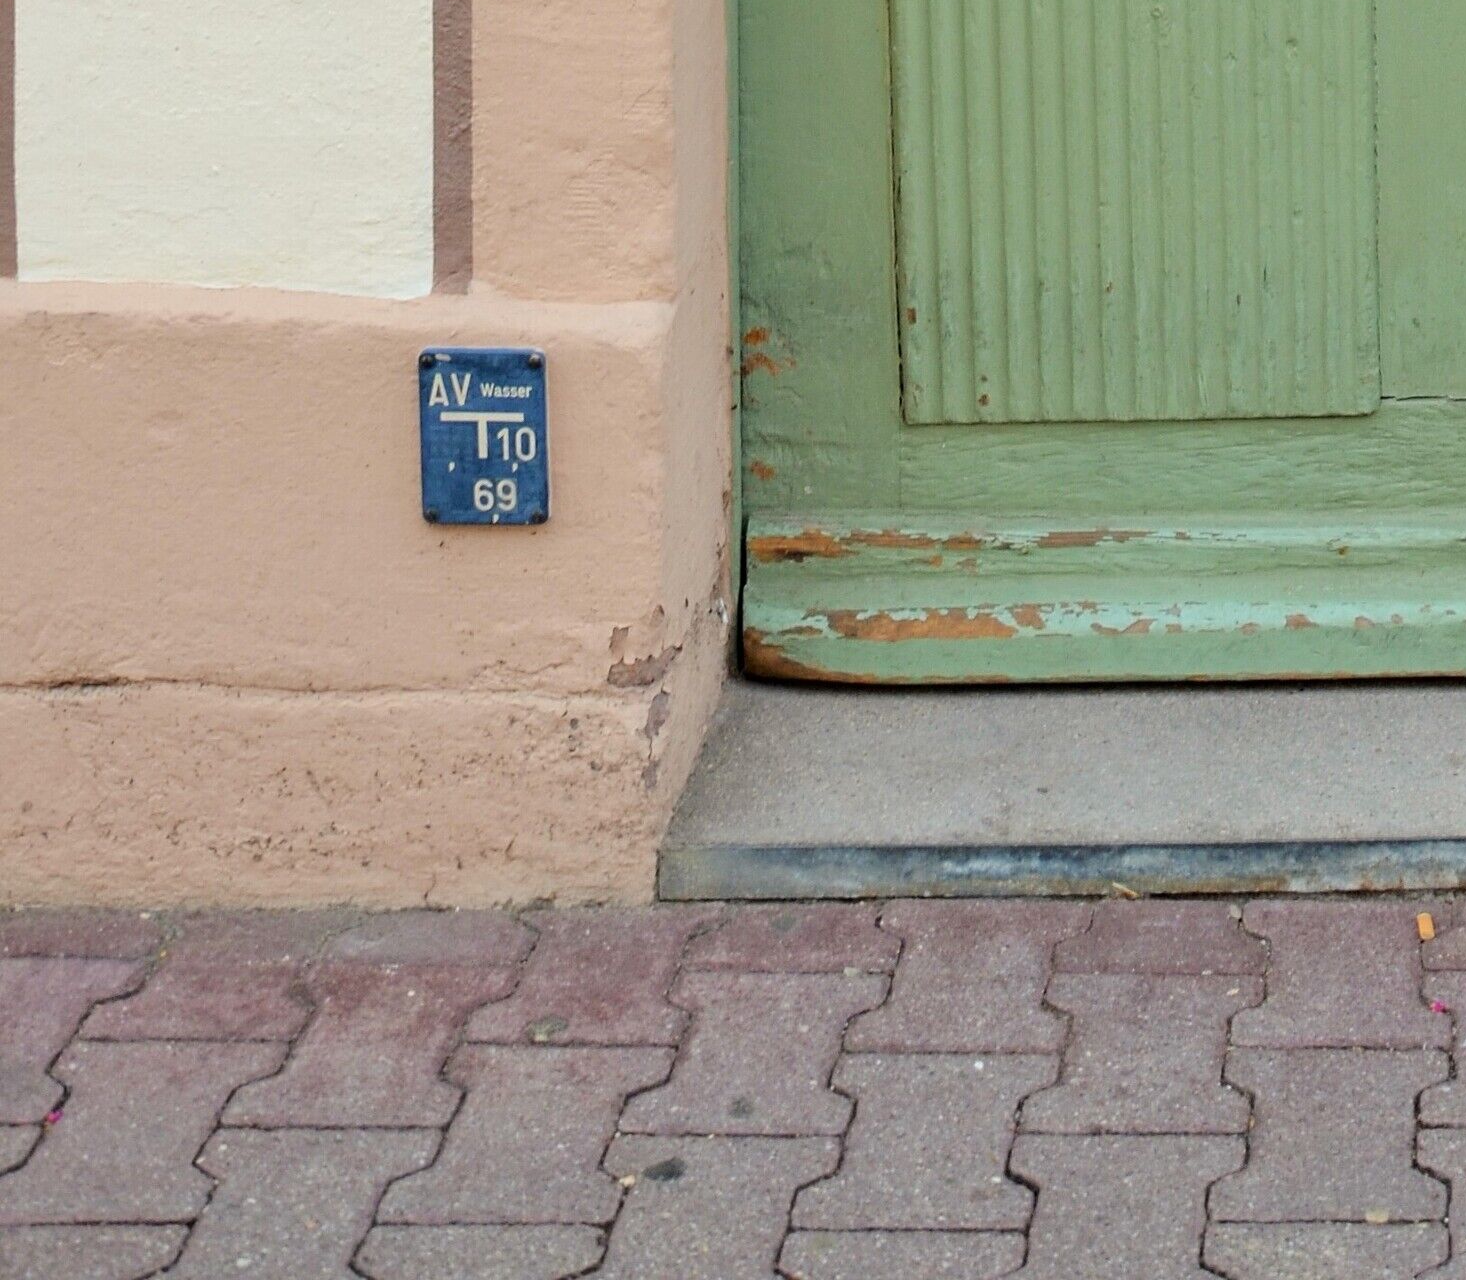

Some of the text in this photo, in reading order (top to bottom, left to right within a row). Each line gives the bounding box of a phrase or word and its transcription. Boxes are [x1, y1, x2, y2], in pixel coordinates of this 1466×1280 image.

[428, 372, 533, 407] AV Wasser
[473, 478, 518, 512] 69
